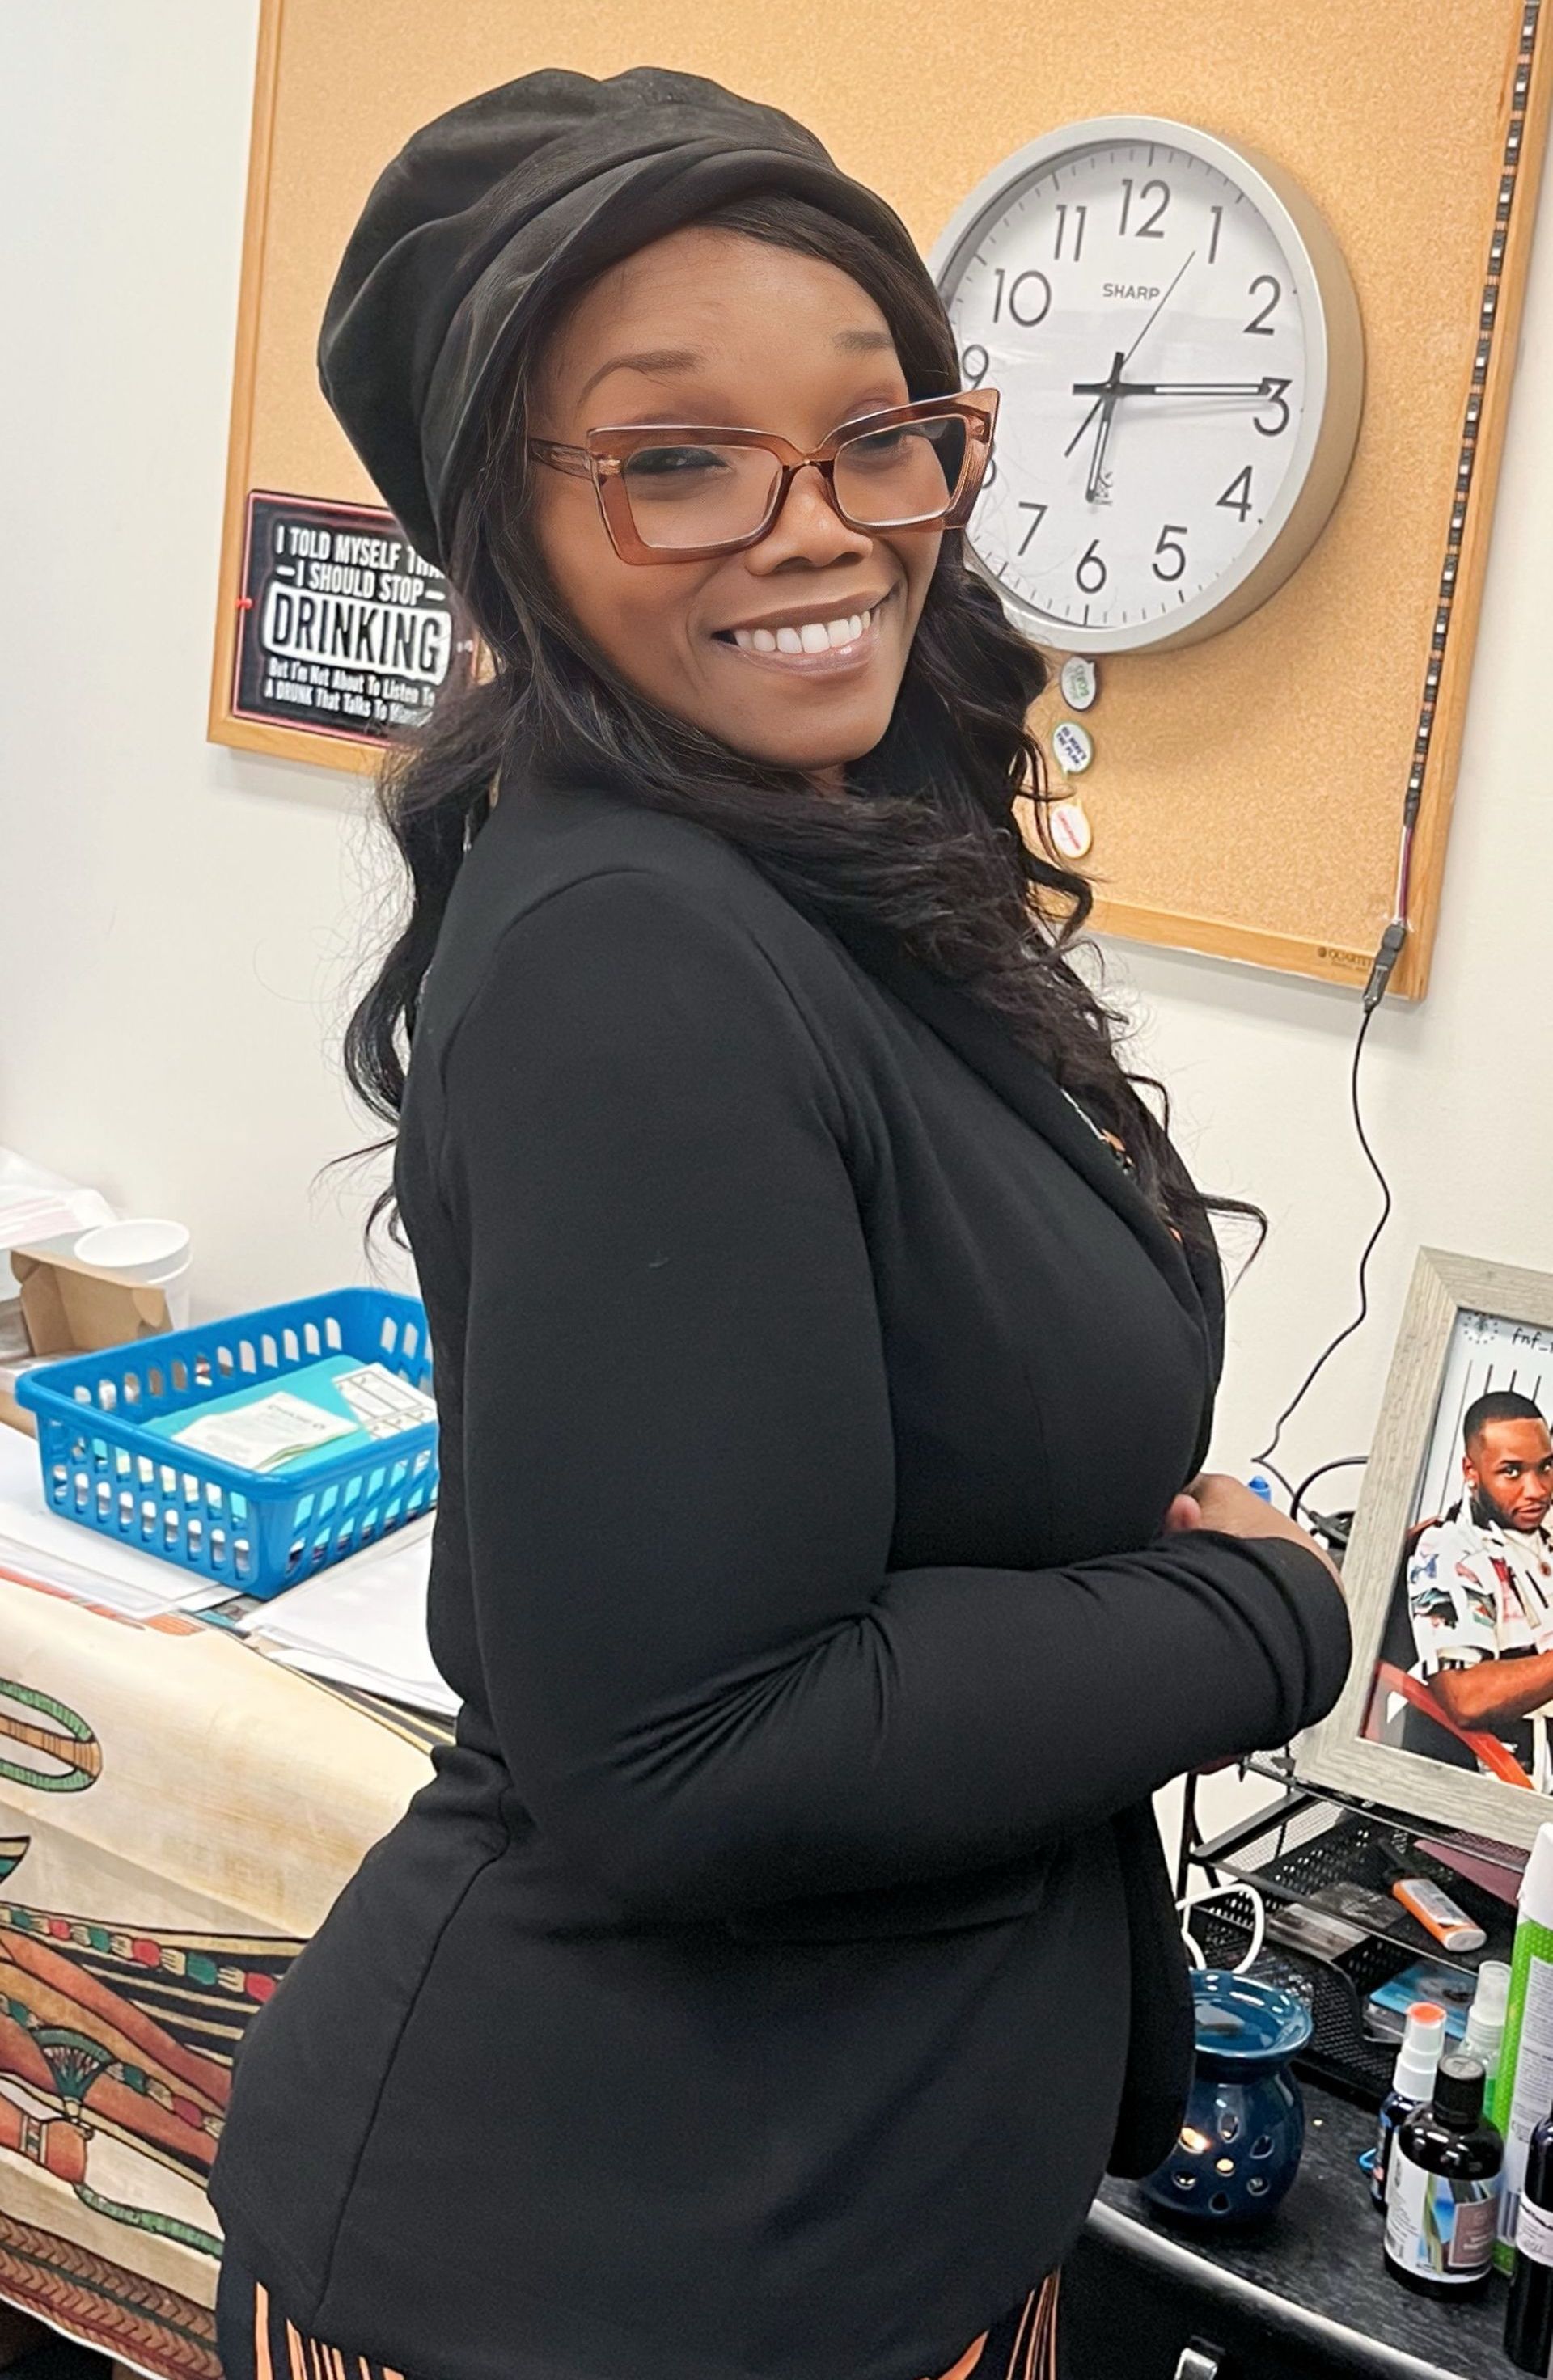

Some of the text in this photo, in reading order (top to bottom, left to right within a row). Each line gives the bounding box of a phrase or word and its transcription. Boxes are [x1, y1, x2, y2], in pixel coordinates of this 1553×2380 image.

[1054, 204, 1087, 261] 11
[1119, 178, 1170, 238] 12
[1208, 205, 1224, 264] 1
[992, 268, 1052, 327] 10
[1102, 283, 1161, 300] SHARP
[1243, 275, 1281, 335] 2
[1253, 376, 1293, 437] 3
[1216, 465, 1253, 522] 4
[276, 526, 285, 554] I
[290, 527, 331, 560] TOLD
[334, 534, 402, 571] MYSELF
[1018, 501, 1047, 556] 7
[1152, 524, 1187, 581] 5
[297, 560, 425, 607] I SHOULD STOP
[1075, 539, 1107, 593] 6
[272, 592, 441, 674] DRINKING
[264, 678, 273, 698] A
[276, 680, 313, 706] DRUNK
[315, 687, 340, 712] That
[342, 692, 372, 717] Talks
[374, 699, 387, 721] To
[269, 657, 435, 708] But I'm Not About To Listen To
